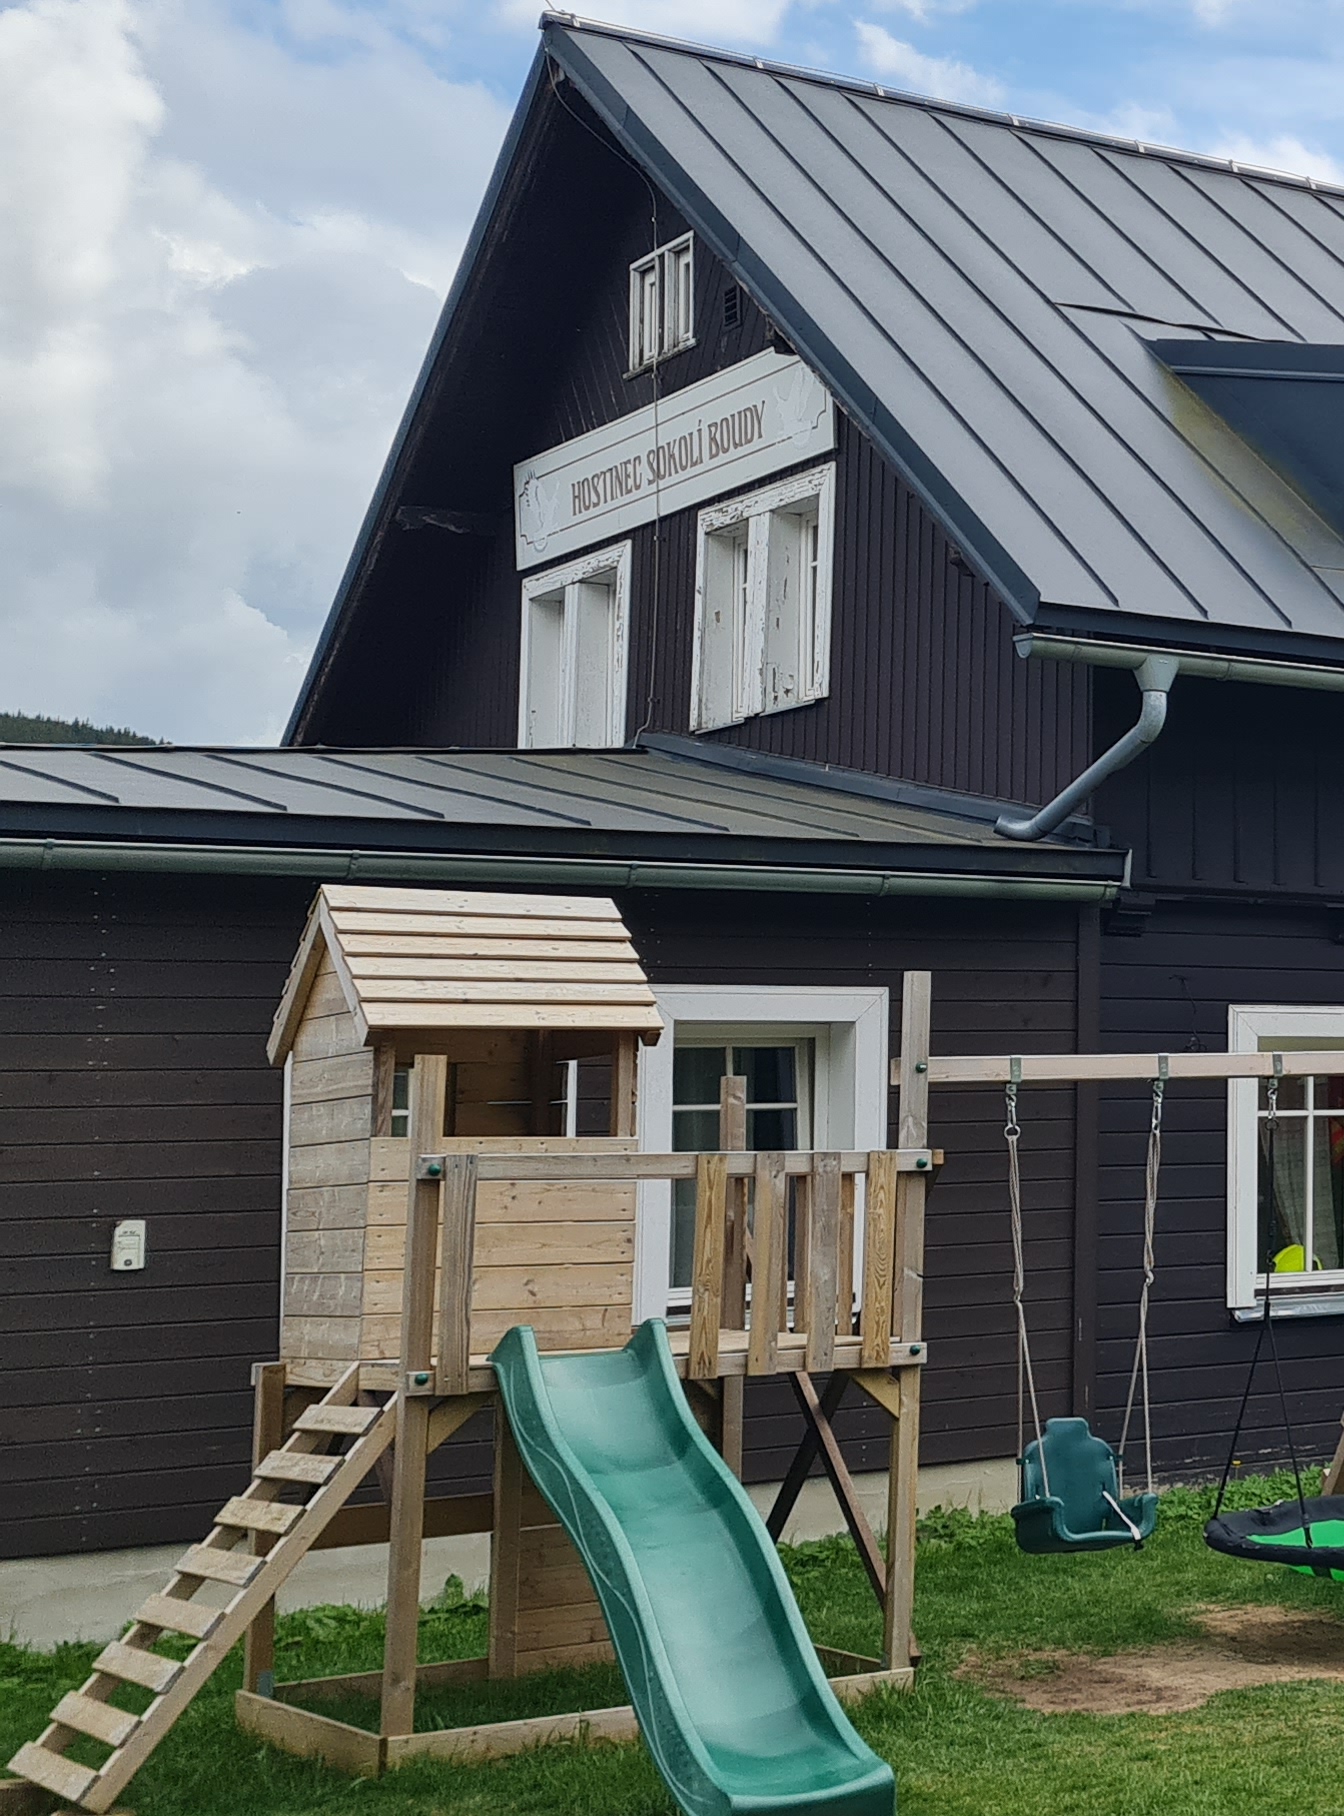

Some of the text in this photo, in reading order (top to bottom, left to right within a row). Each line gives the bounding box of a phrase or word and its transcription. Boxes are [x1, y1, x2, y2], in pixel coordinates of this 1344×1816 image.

[570, 400, 766, 517] HOSTINEC SOKOLÍ BOUDY
